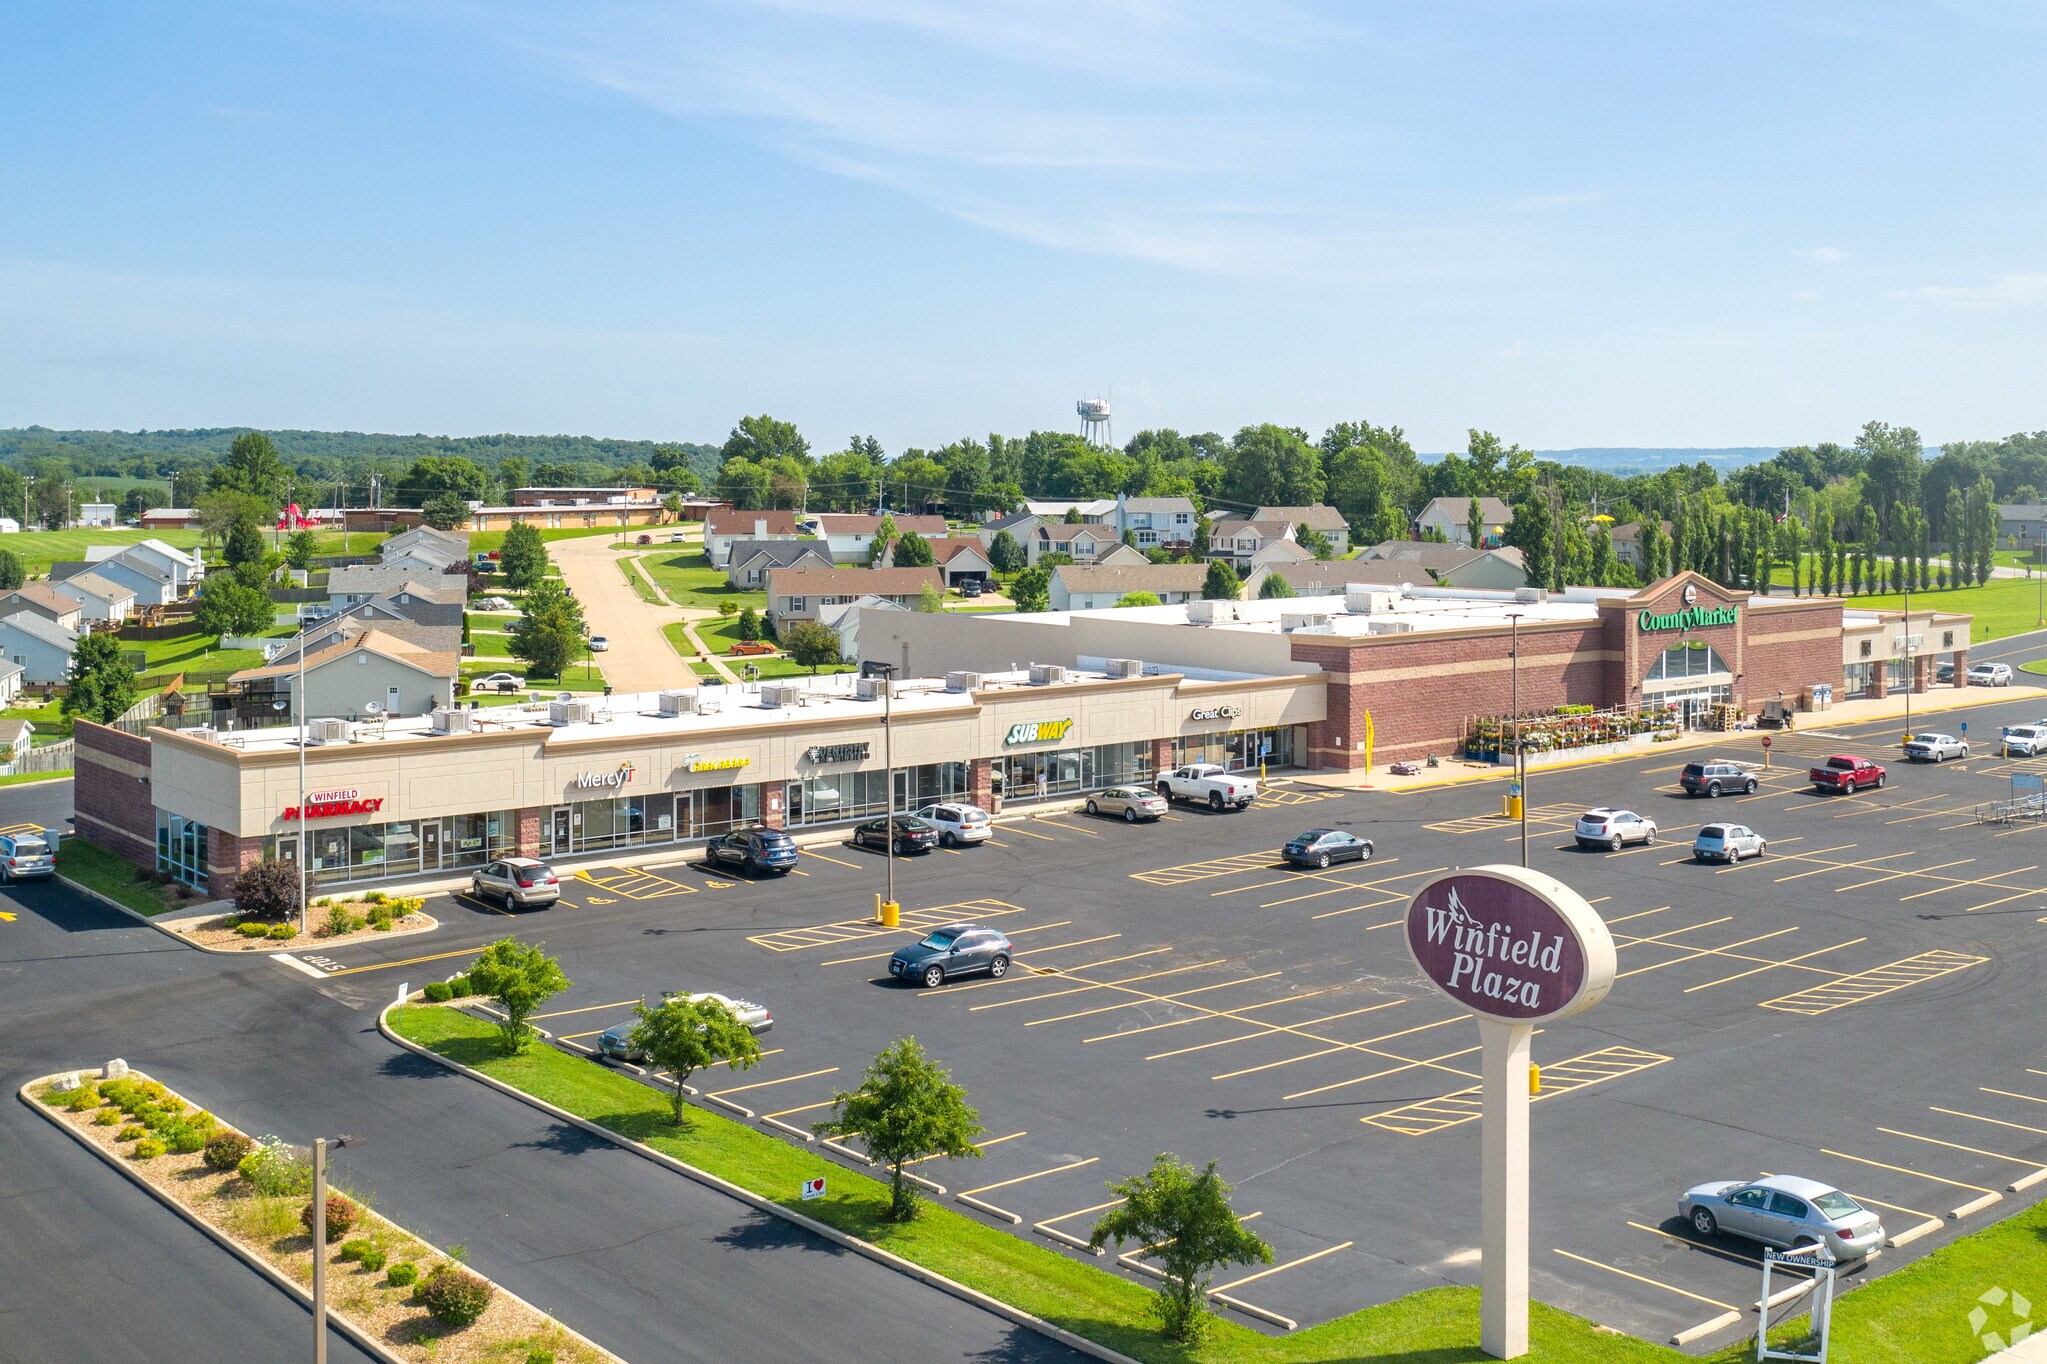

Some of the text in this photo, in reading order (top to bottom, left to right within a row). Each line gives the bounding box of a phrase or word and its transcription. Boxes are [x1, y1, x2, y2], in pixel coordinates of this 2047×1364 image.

[1192, 706, 1242, 721] Great Clips
[1006, 717, 1073, 745] SUBWAY
[577, 771, 623, 788] Mercy
[314, 789, 358, 802] WINFIELD
[284, 797, 384, 822] PHARMACY
[1425, 905, 1565, 974] Winfield
[1446, 951, 1541, 1009] Plaza
[806, 1181, 813, 1193] I
[1766, 1251, 1835, 1268] NEW OWNERSHIP
